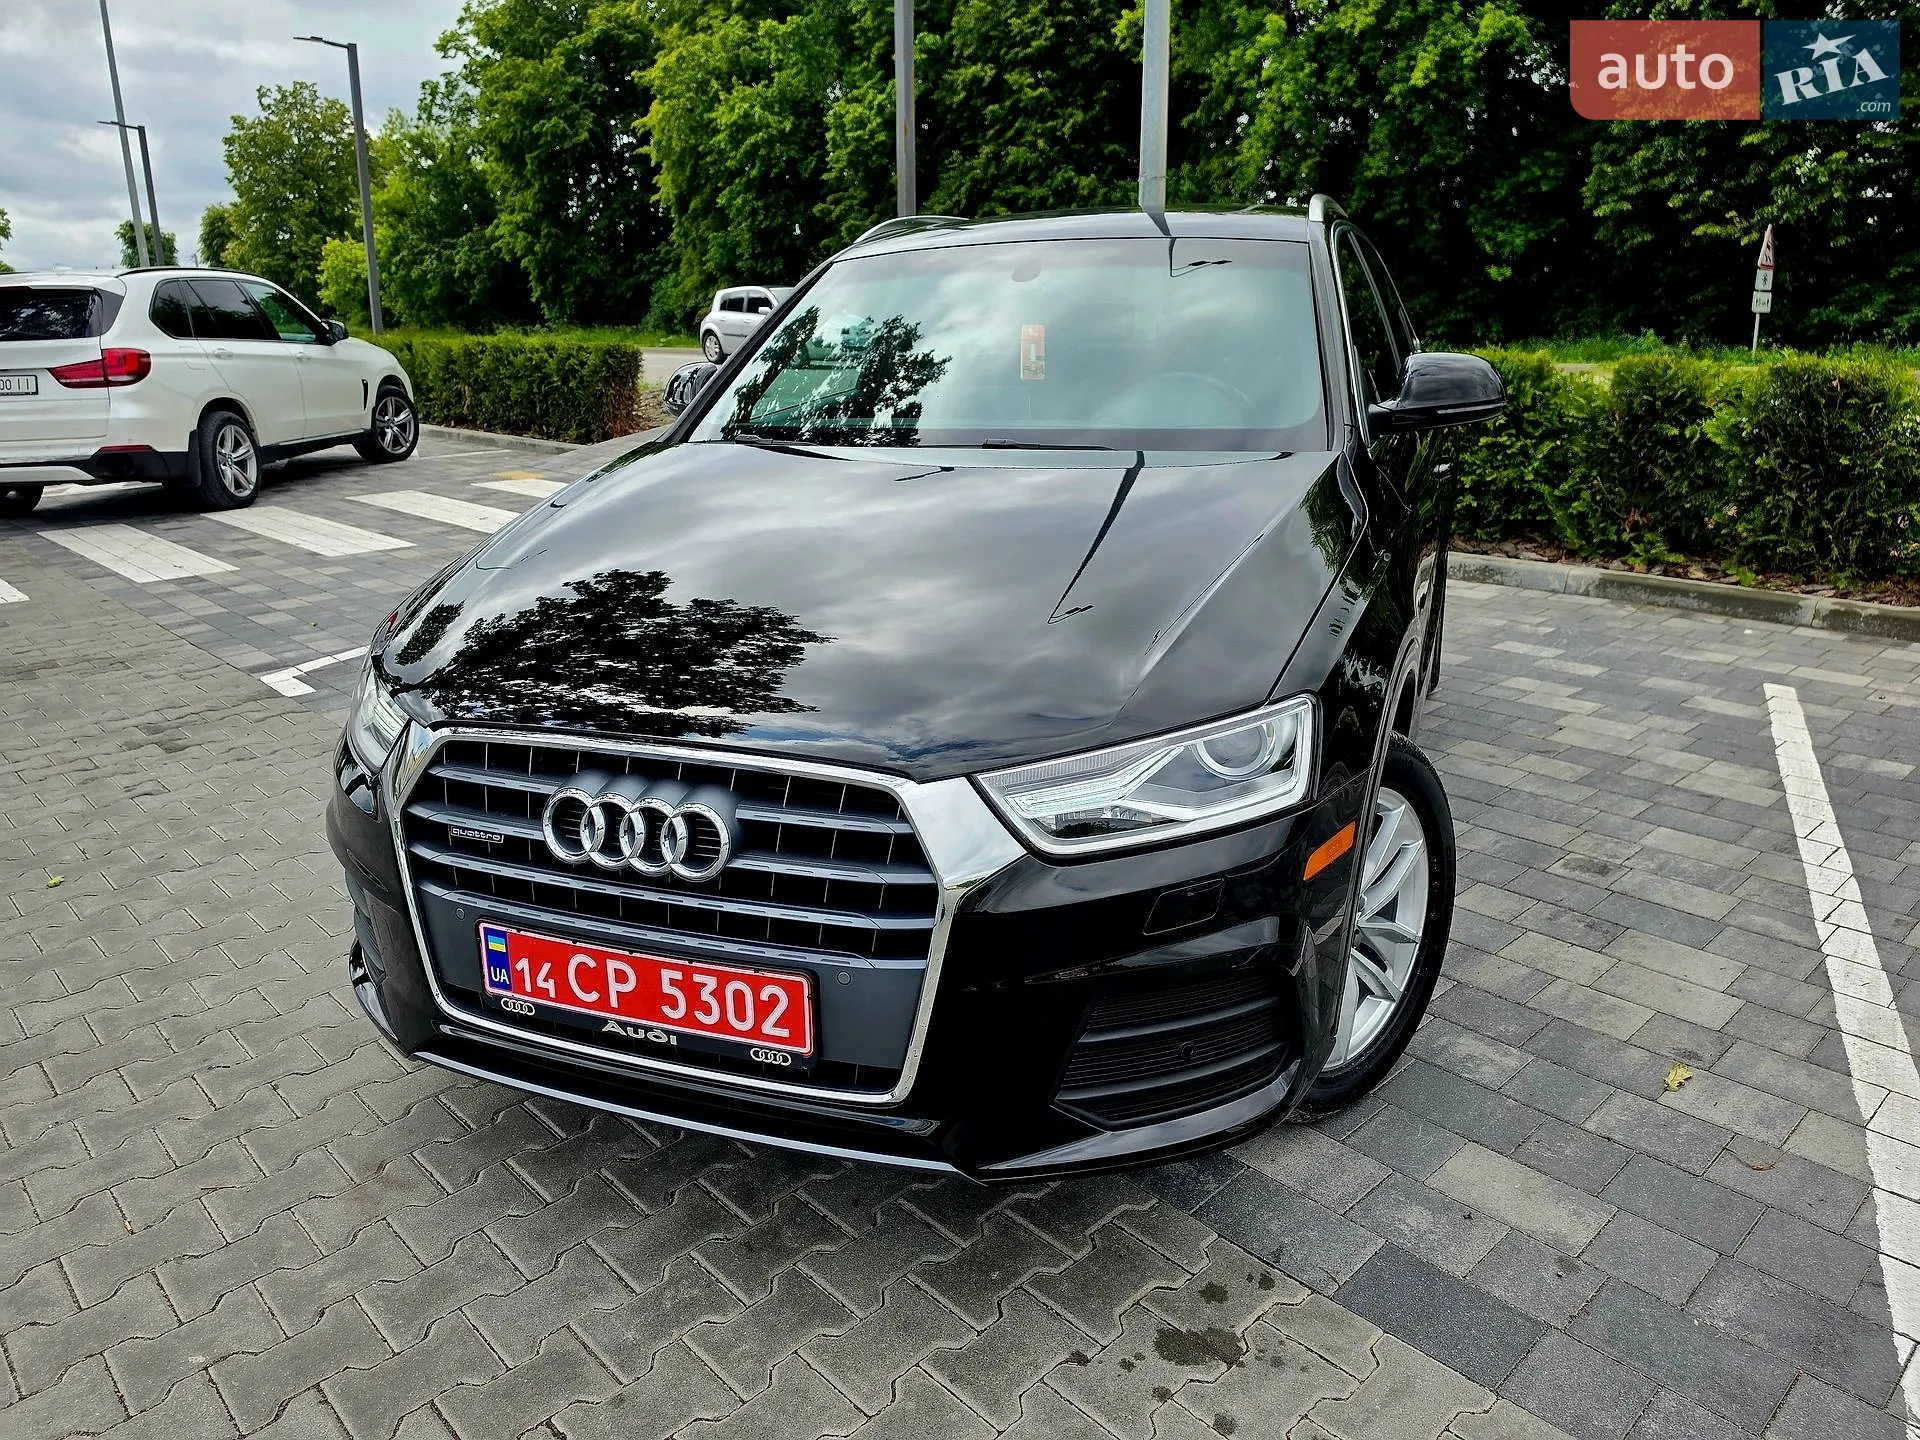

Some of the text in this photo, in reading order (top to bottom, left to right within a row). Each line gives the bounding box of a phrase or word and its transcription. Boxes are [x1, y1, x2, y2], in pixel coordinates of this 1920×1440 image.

[452, 828, 501, 841] quattro
[491, 966, 510, 985] UA
[515, 953, 790, 1038] 14 CP 5302
[602, 1020, 677, 1046] Audi
